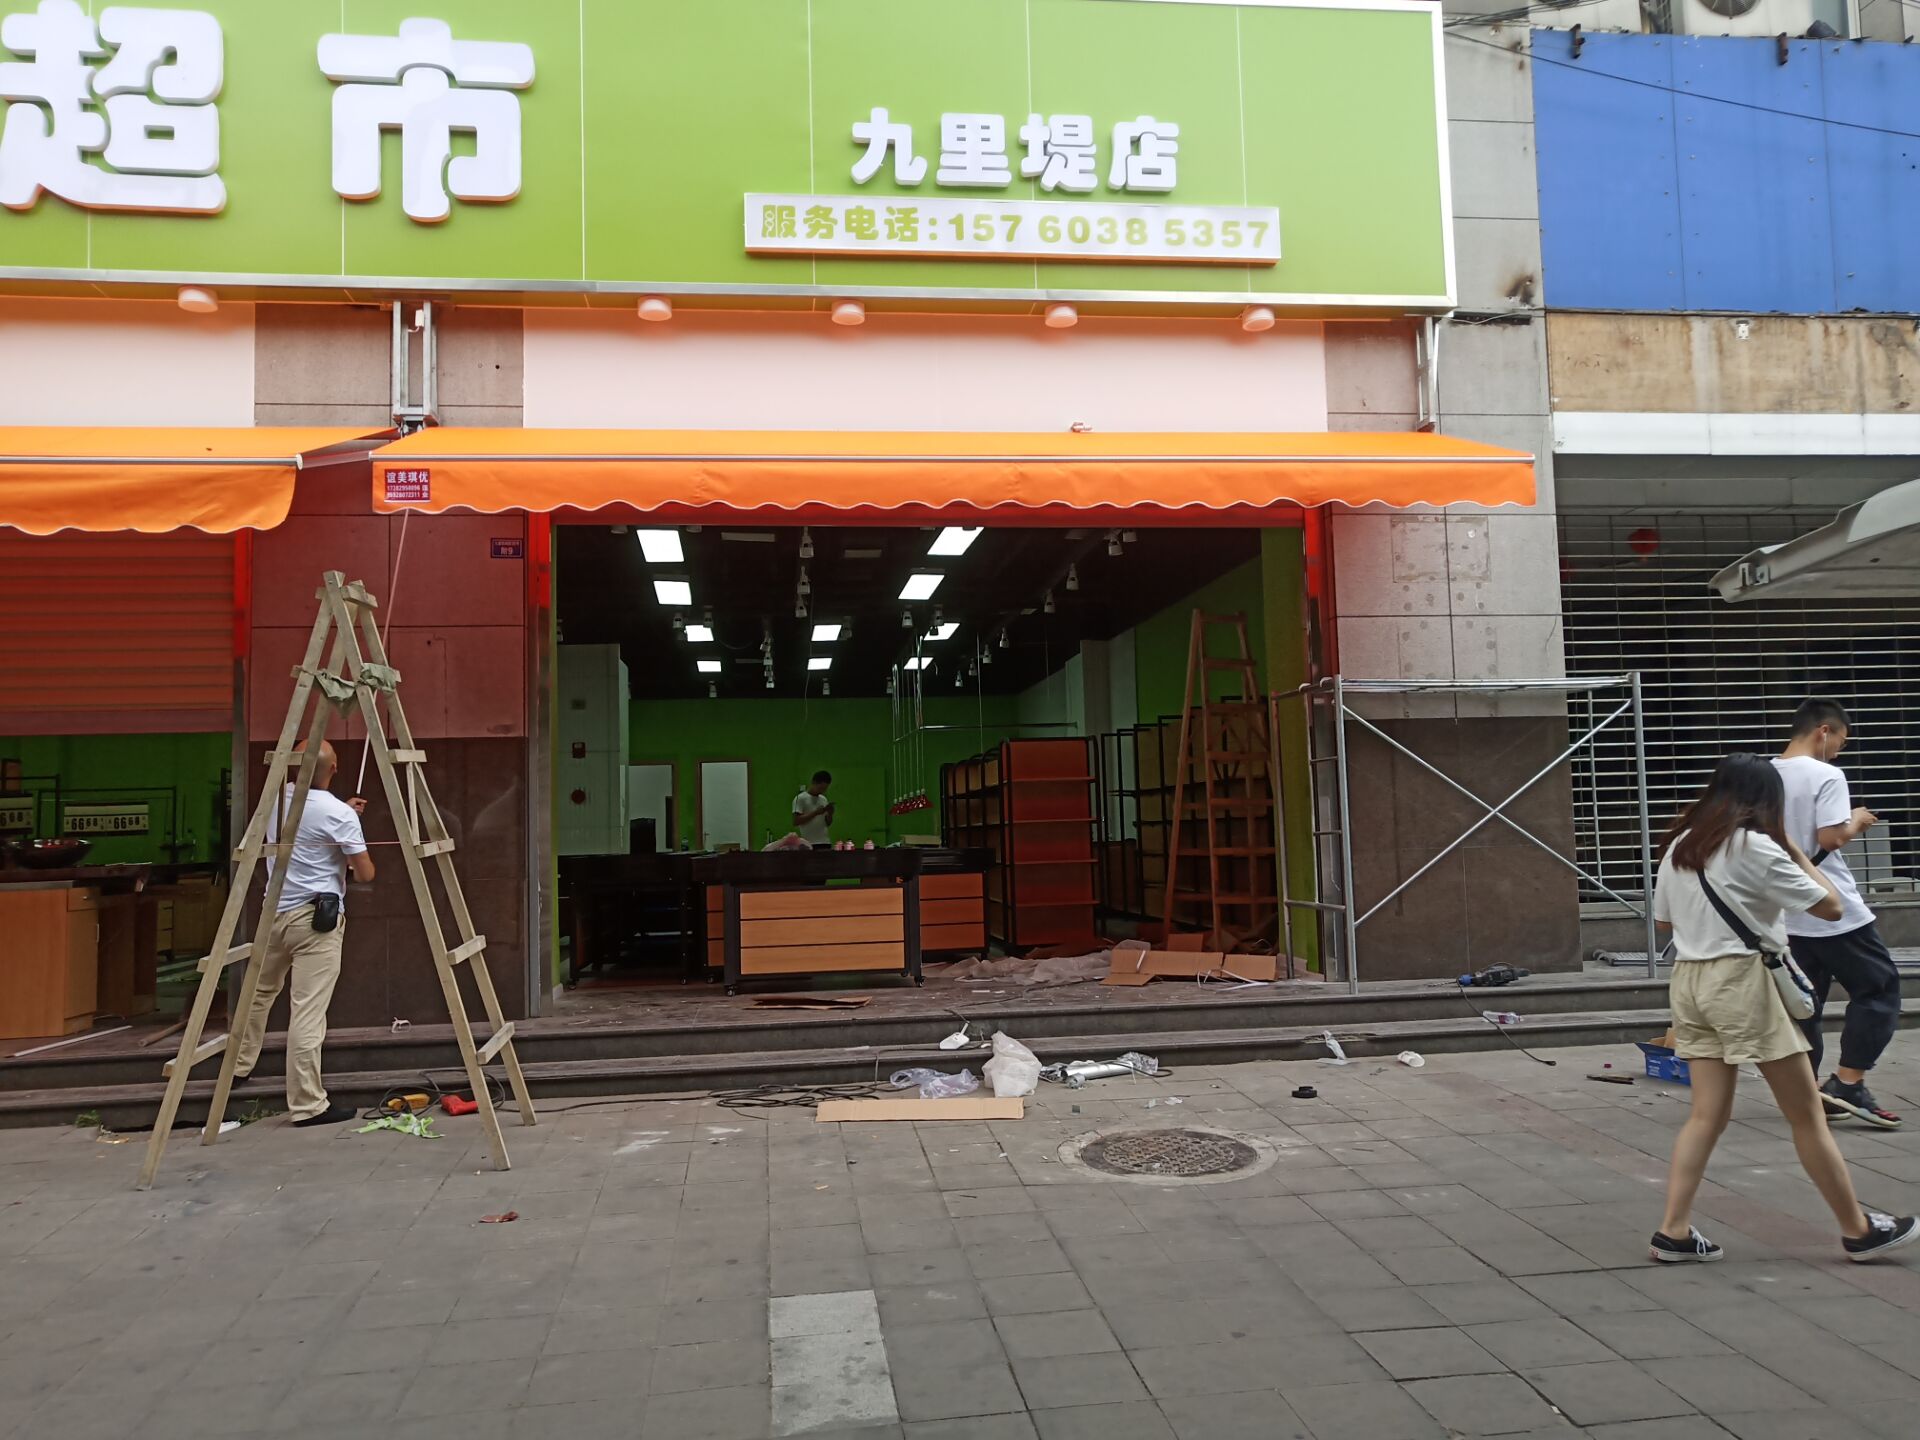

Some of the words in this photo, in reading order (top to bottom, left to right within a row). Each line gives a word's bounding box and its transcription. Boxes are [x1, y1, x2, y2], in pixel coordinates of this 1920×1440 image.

[0, 0, 536, 224] 超市
[850, 106, 1180, 193] 九里堤店
[1037, 214, 1149, 246] 6038
[1164, 218, 1270, 249] 5357
